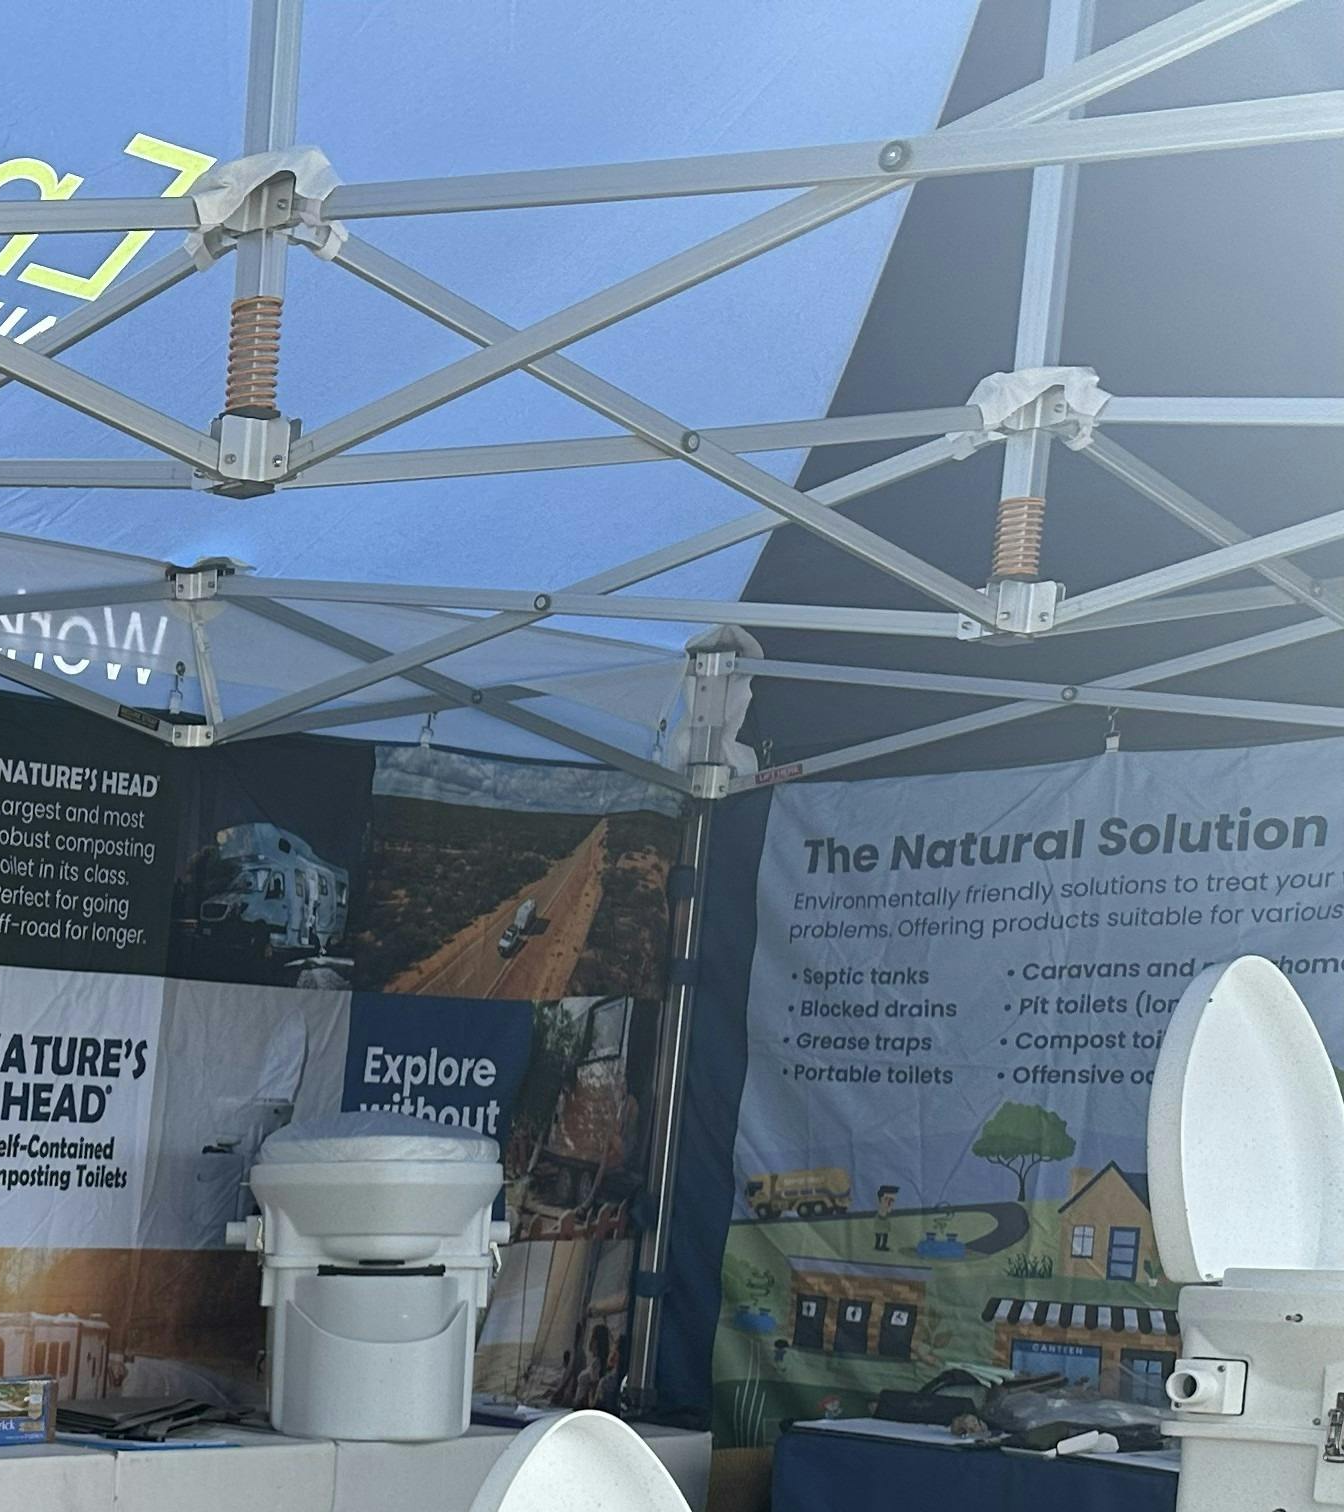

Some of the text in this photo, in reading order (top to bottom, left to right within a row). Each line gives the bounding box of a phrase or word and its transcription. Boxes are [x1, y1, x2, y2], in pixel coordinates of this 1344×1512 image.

[66, 805, 99, 824] and
[104, 811, 144, 828] most
[56, 835, 155, 864] composting
[804, 807, 1328, 874] The Natural Solution
[39, 858, 54, 878] in
[60, 861, 78, 881] its
[85, 864, 128, 885] class.
[56, 889, 78, 909] for
[83, 894, 129, 920] going
[794, 872, 1335, 910] Environmentally friendly solutions to treat your
[65, 920, 88, 939] for
[92, 923, 146, 949] longer.
[790, 904, 1344, 944] problems. Offering products suitable for various
[804, 967, 929, 990] Septic tanks
[801, 999, 956, 1018] Blocked drains
[797, 1032, 932, 1056] Grease traps
[364, 1047, 496, 1096] Explore
[794, 1064, 953, 1084] Portable toilets
[76, 1164, 127, 1188] Toilets
[1032, 1343, 1083, 1355] CANTEEN
